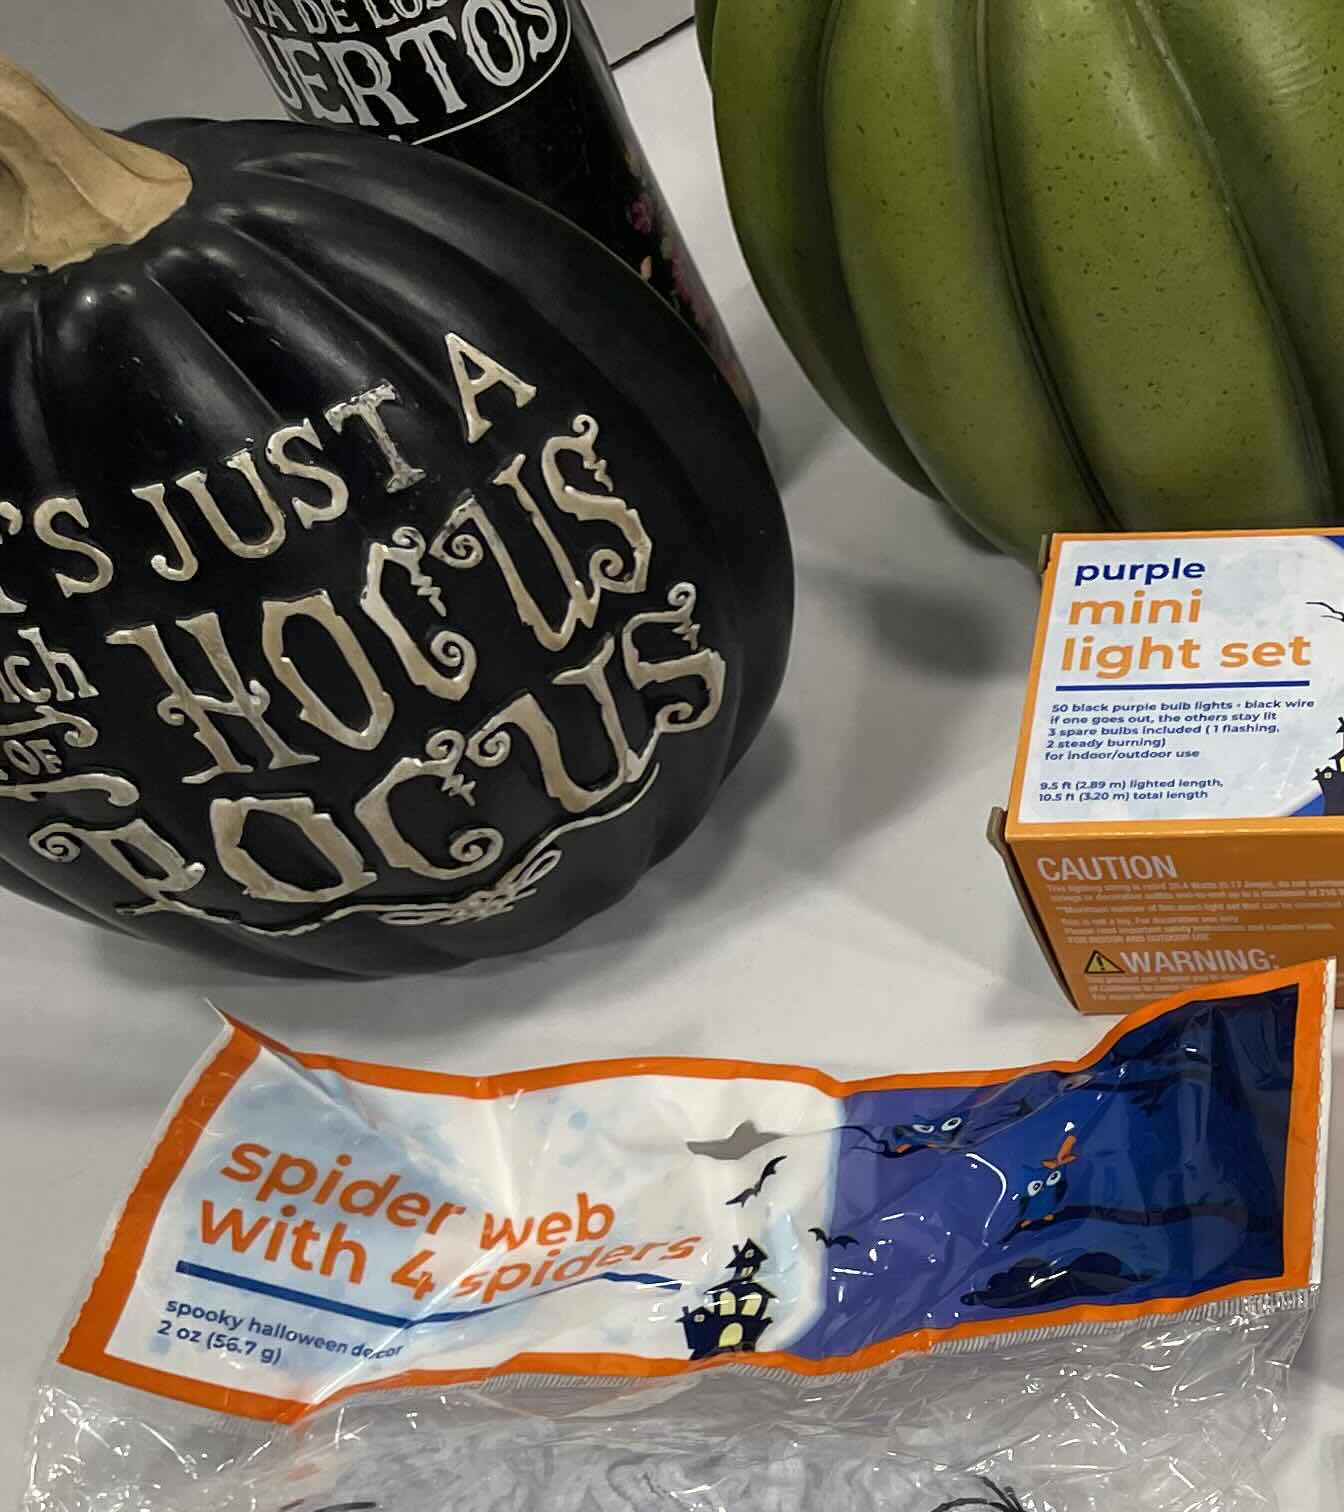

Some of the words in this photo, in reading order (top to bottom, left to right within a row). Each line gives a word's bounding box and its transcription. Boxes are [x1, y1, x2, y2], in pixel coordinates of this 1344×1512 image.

[0, 497, 113, 613] 'S
[131, 382, 425, 582] JUST
[444, 332, 536, 442] A
[1074, 557, 1206, 587] purple
[0, 627, 99, 703] ch
[105, 415, 650, 784] HOCUS
[1069, 588, 1203, 625] mini
[1061, 636, 1201, 680] light
[1220, 634, 1311, 669] set
[29, 582, 726, 917] POCUS
[1037, 854, 1179, 882] CAUTION
[1120, 947, 1278, 974] WARNING:
[220, 1140, 466, 1236] spider
[476, 1193, 615, 1252] web
[199, 1198, 366, 1285] with
[390, 1249, 434, 1299] 4
[456, 1233, 703, 1305] spiders
[157, 1319, 171, 1336] 2
[176, 1326, 203, 1342] oz
[205, 1331, 257, 1358] (56.7
[260, 1344, 282, 1366] g)
[165, 1297, 244, 1334] spooky
[247, 1316, 349, 1357] halloween
